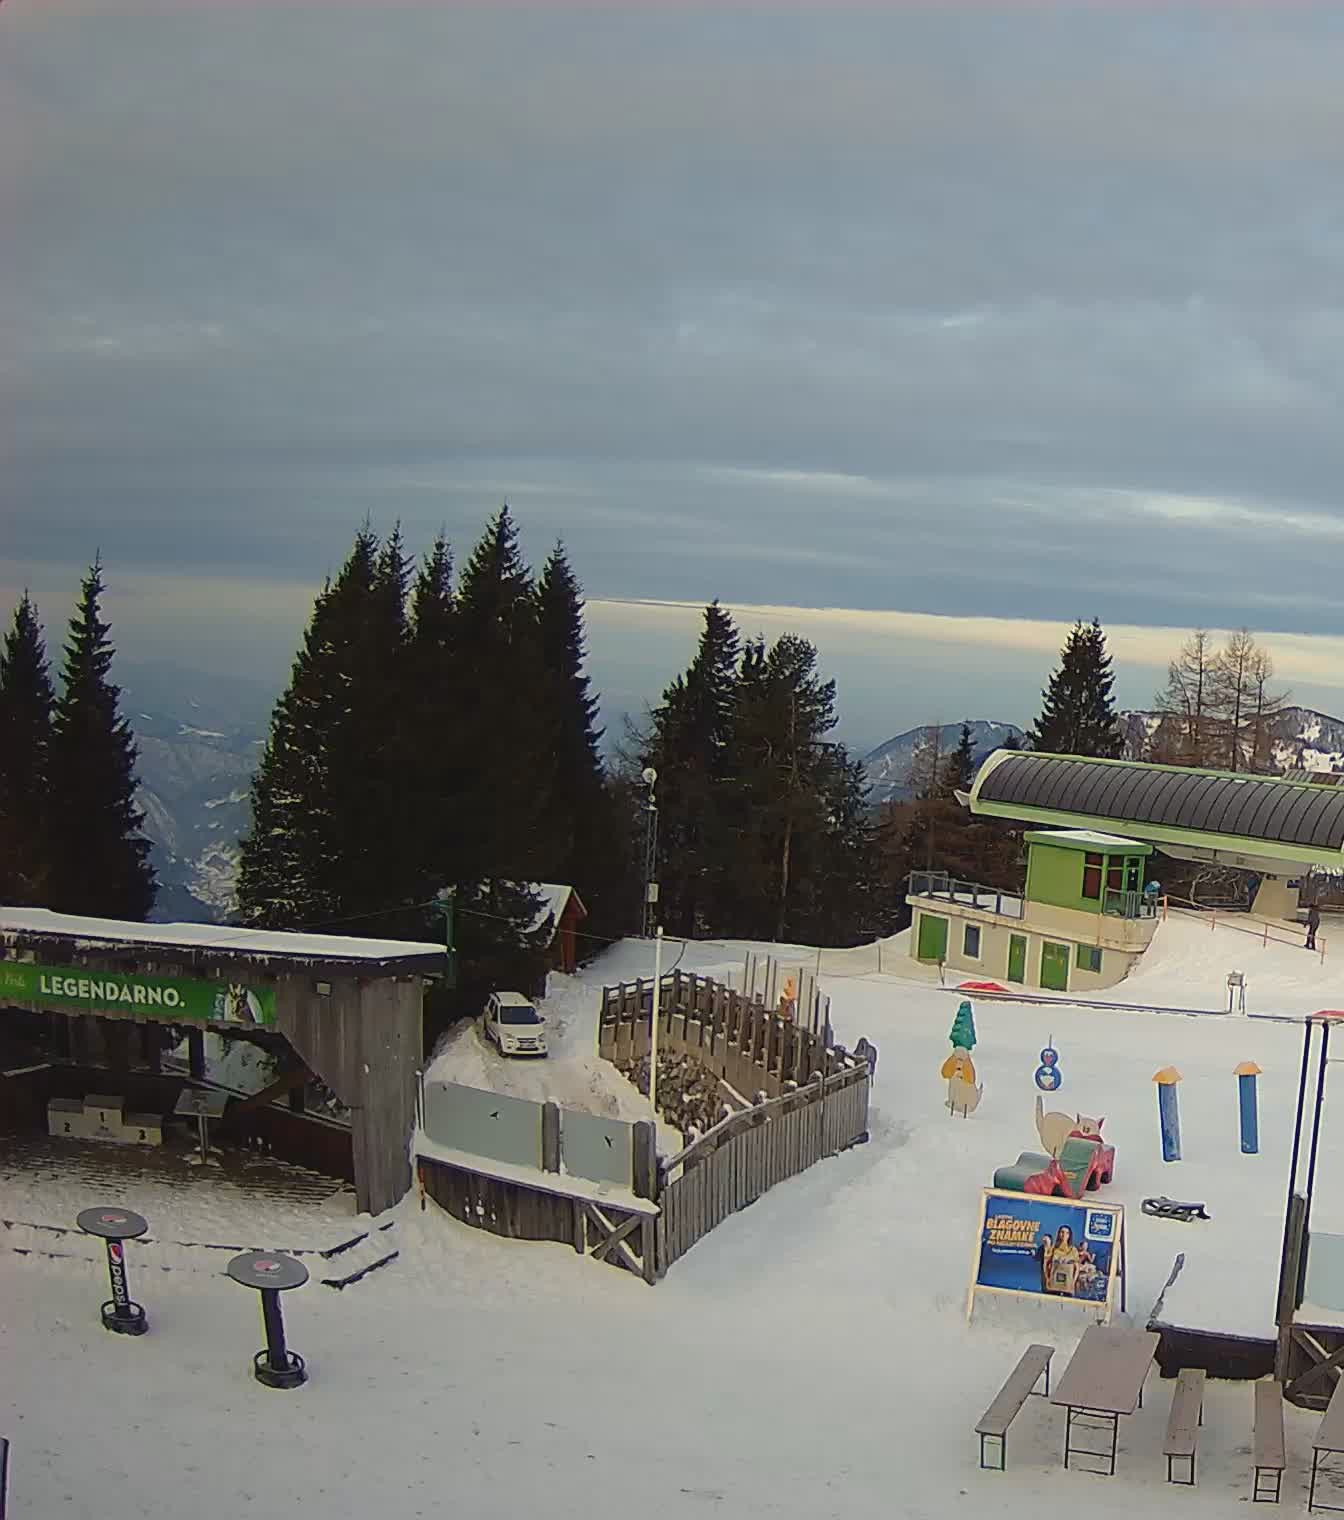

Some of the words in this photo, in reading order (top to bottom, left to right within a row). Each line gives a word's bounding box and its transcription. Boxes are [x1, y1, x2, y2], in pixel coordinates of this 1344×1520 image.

[40, 975, 186, 1007] LEGENDARNO.
[986, 1218, 1040, 1232] BLAGOVNE
[989, 1229, 1035, 1243] ZNAMKE
[111, 1265, 128, 1306] pepsi
